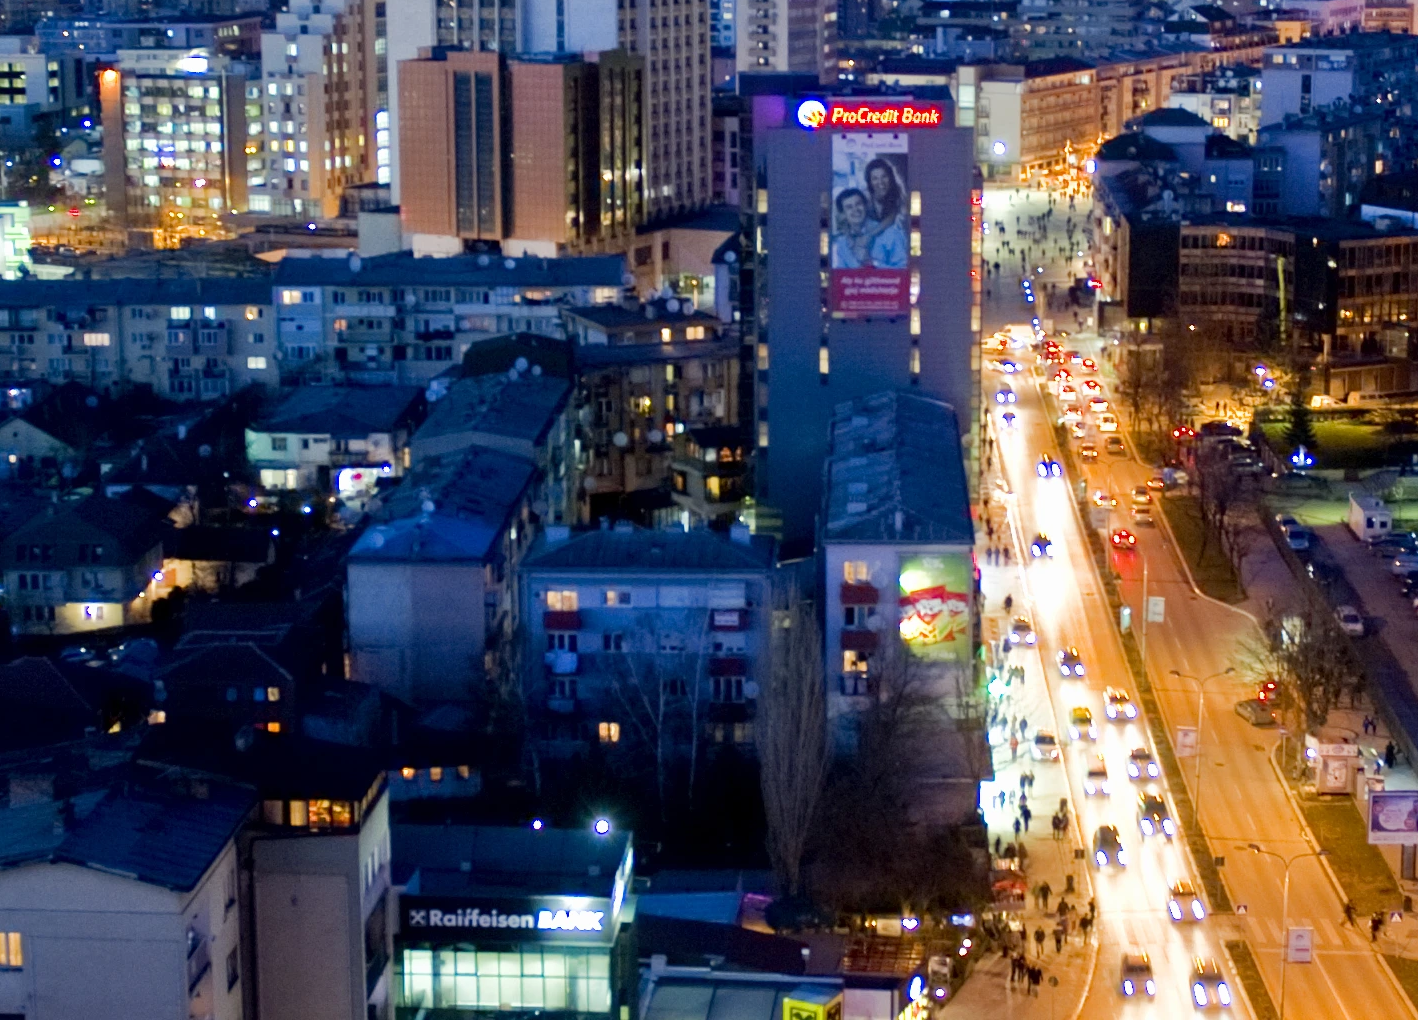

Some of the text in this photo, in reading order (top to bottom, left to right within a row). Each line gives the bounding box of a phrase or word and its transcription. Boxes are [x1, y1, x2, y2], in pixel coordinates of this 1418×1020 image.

[832, 107, 939, 124] ProCredit Bank
[430, 909, 603, 930] Raiffeisen BANK
